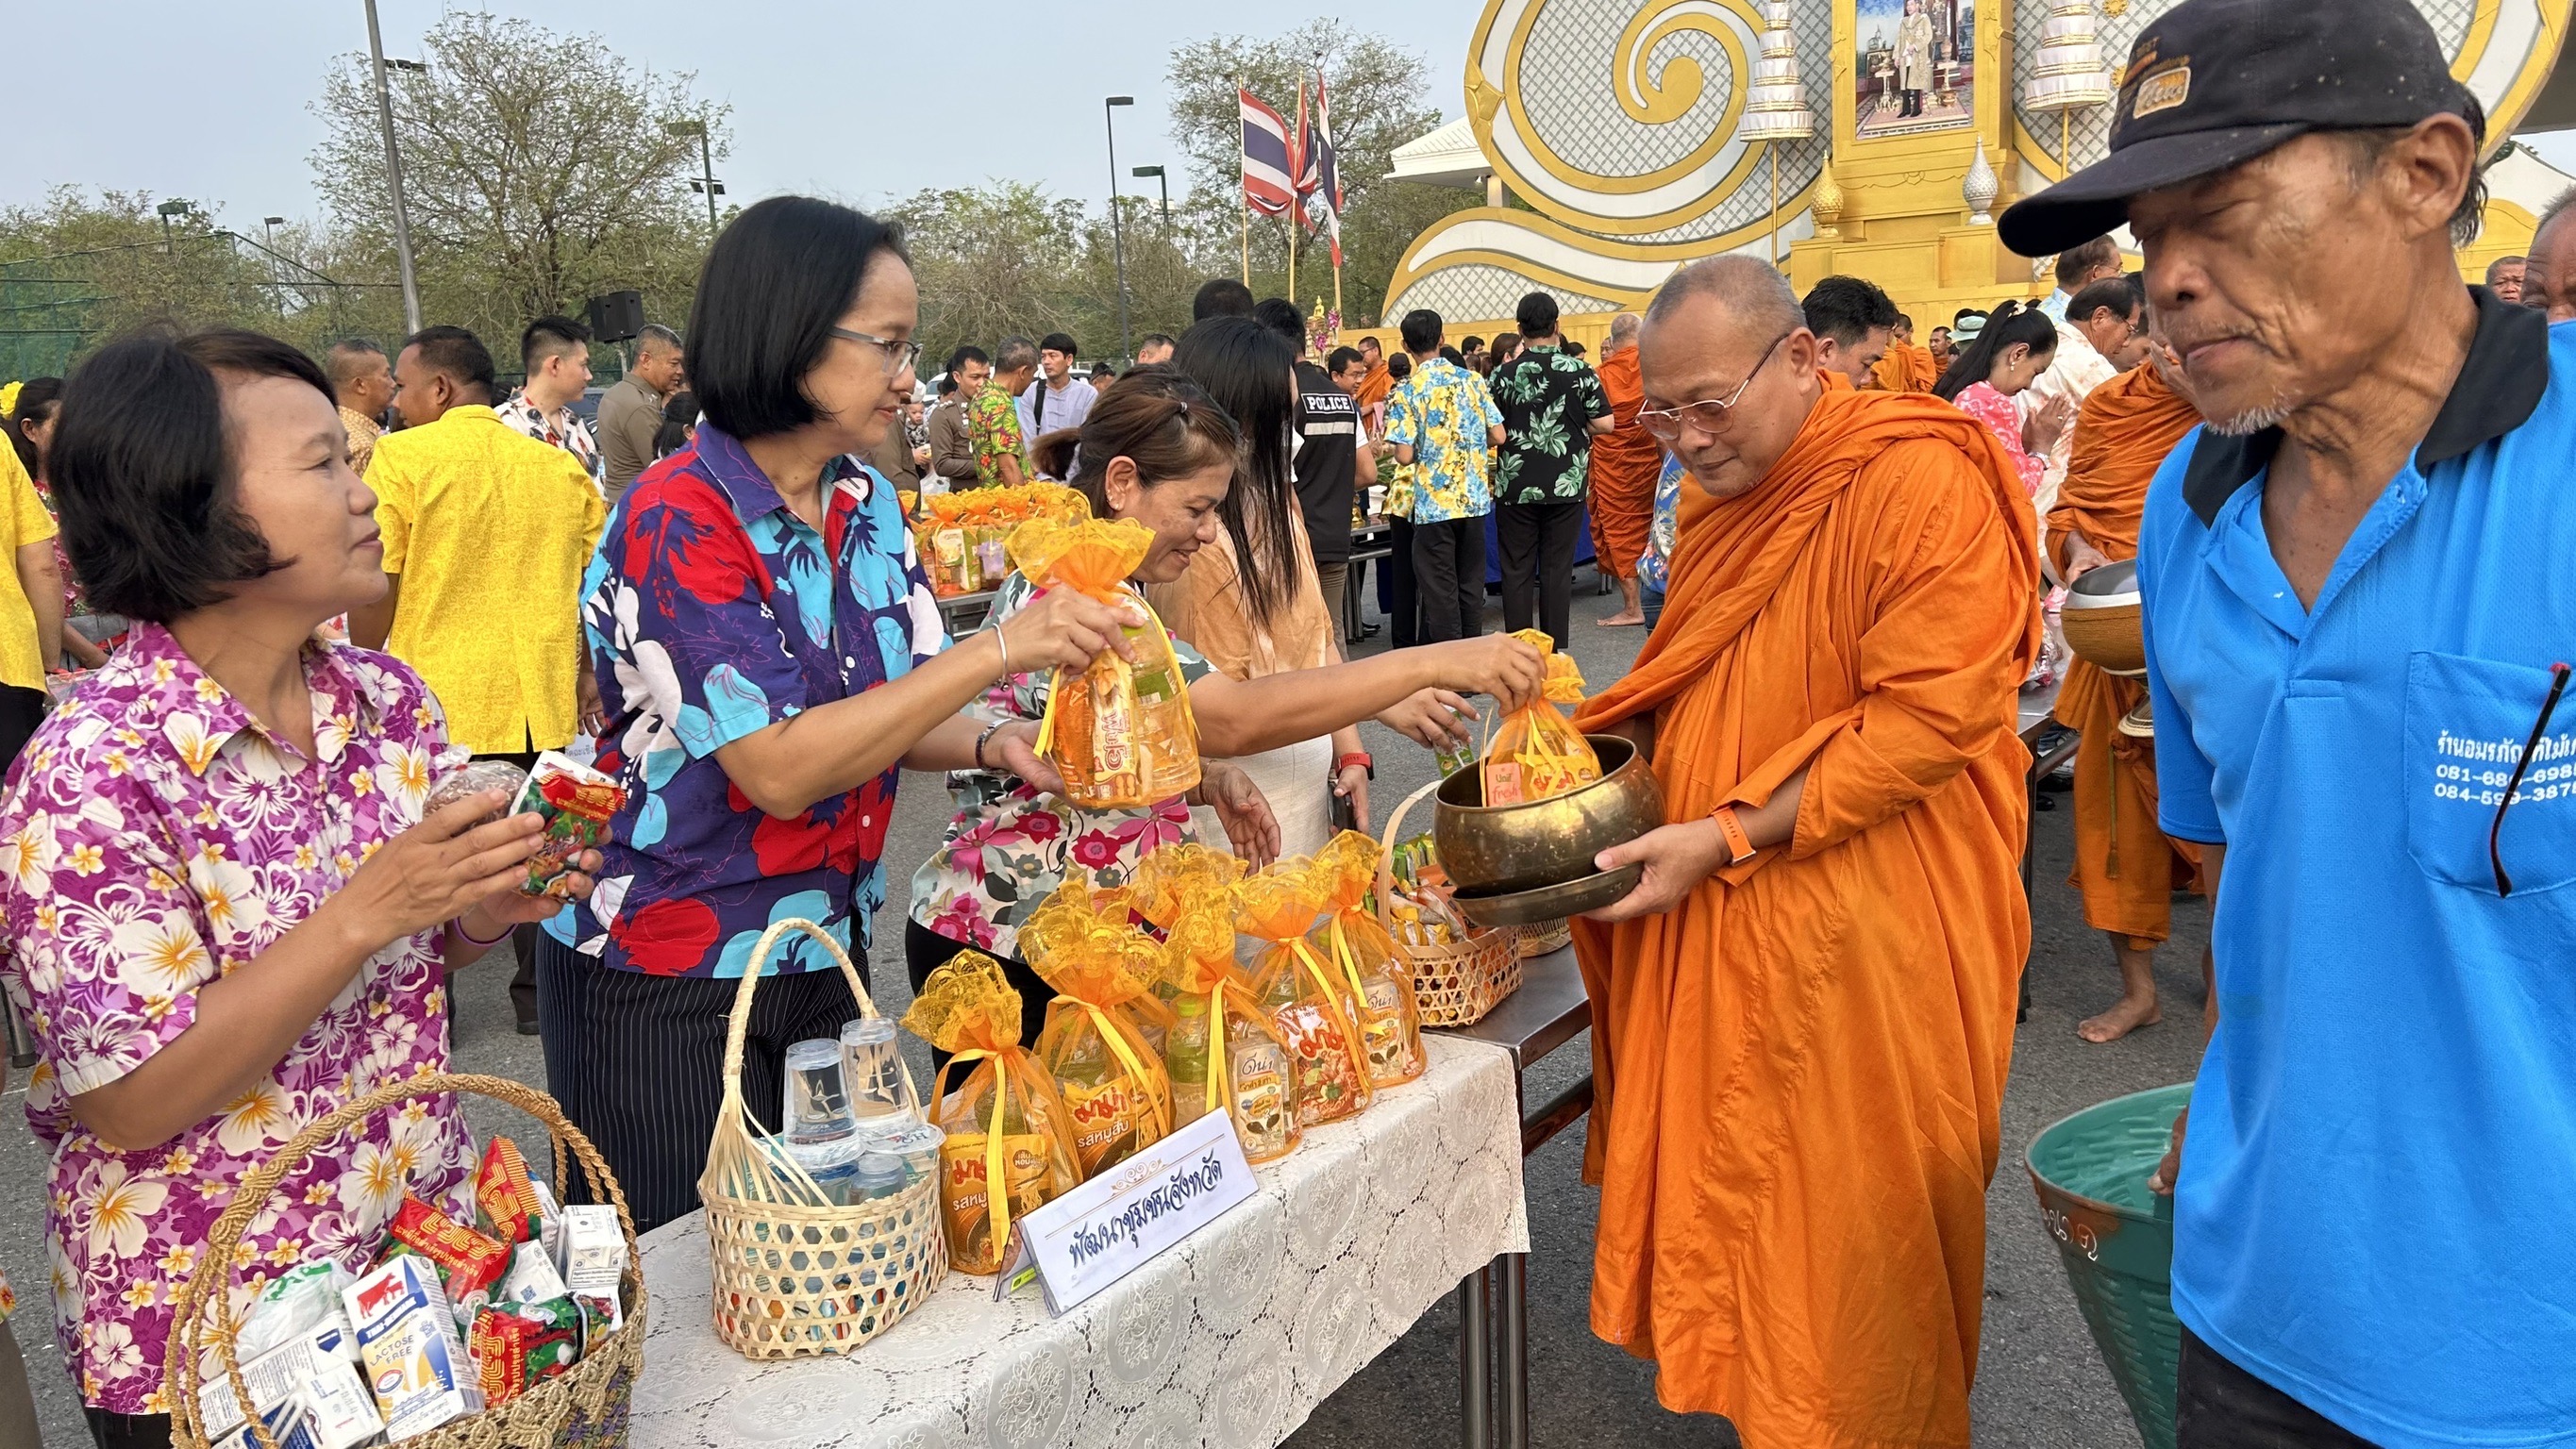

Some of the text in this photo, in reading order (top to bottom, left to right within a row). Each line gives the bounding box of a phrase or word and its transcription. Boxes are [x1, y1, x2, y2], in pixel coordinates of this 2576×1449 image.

[1306, 396, 1351, 410] POLICE
[2435, 763, 2576, 788] 081-68-698
[2434, 781, 2576, 807] 084-599-387
[1298, 1022, 1346, 1058] มาม
[1242, 1052, 1274, 1075] ดีน่า
[1074, 1087, 1128, 1124] มาม่า
[1078, 1118, 1129, 1148] รสหมูสับ
[952, 1191, 988, 1211] รสหมู
[1069, 1148, 1223, 1268] พัฒนาชุมชนจังหวัด
[369, 1334, 414, 1367] LACTOSE
[386, 1346, 412, 1365] FREE
